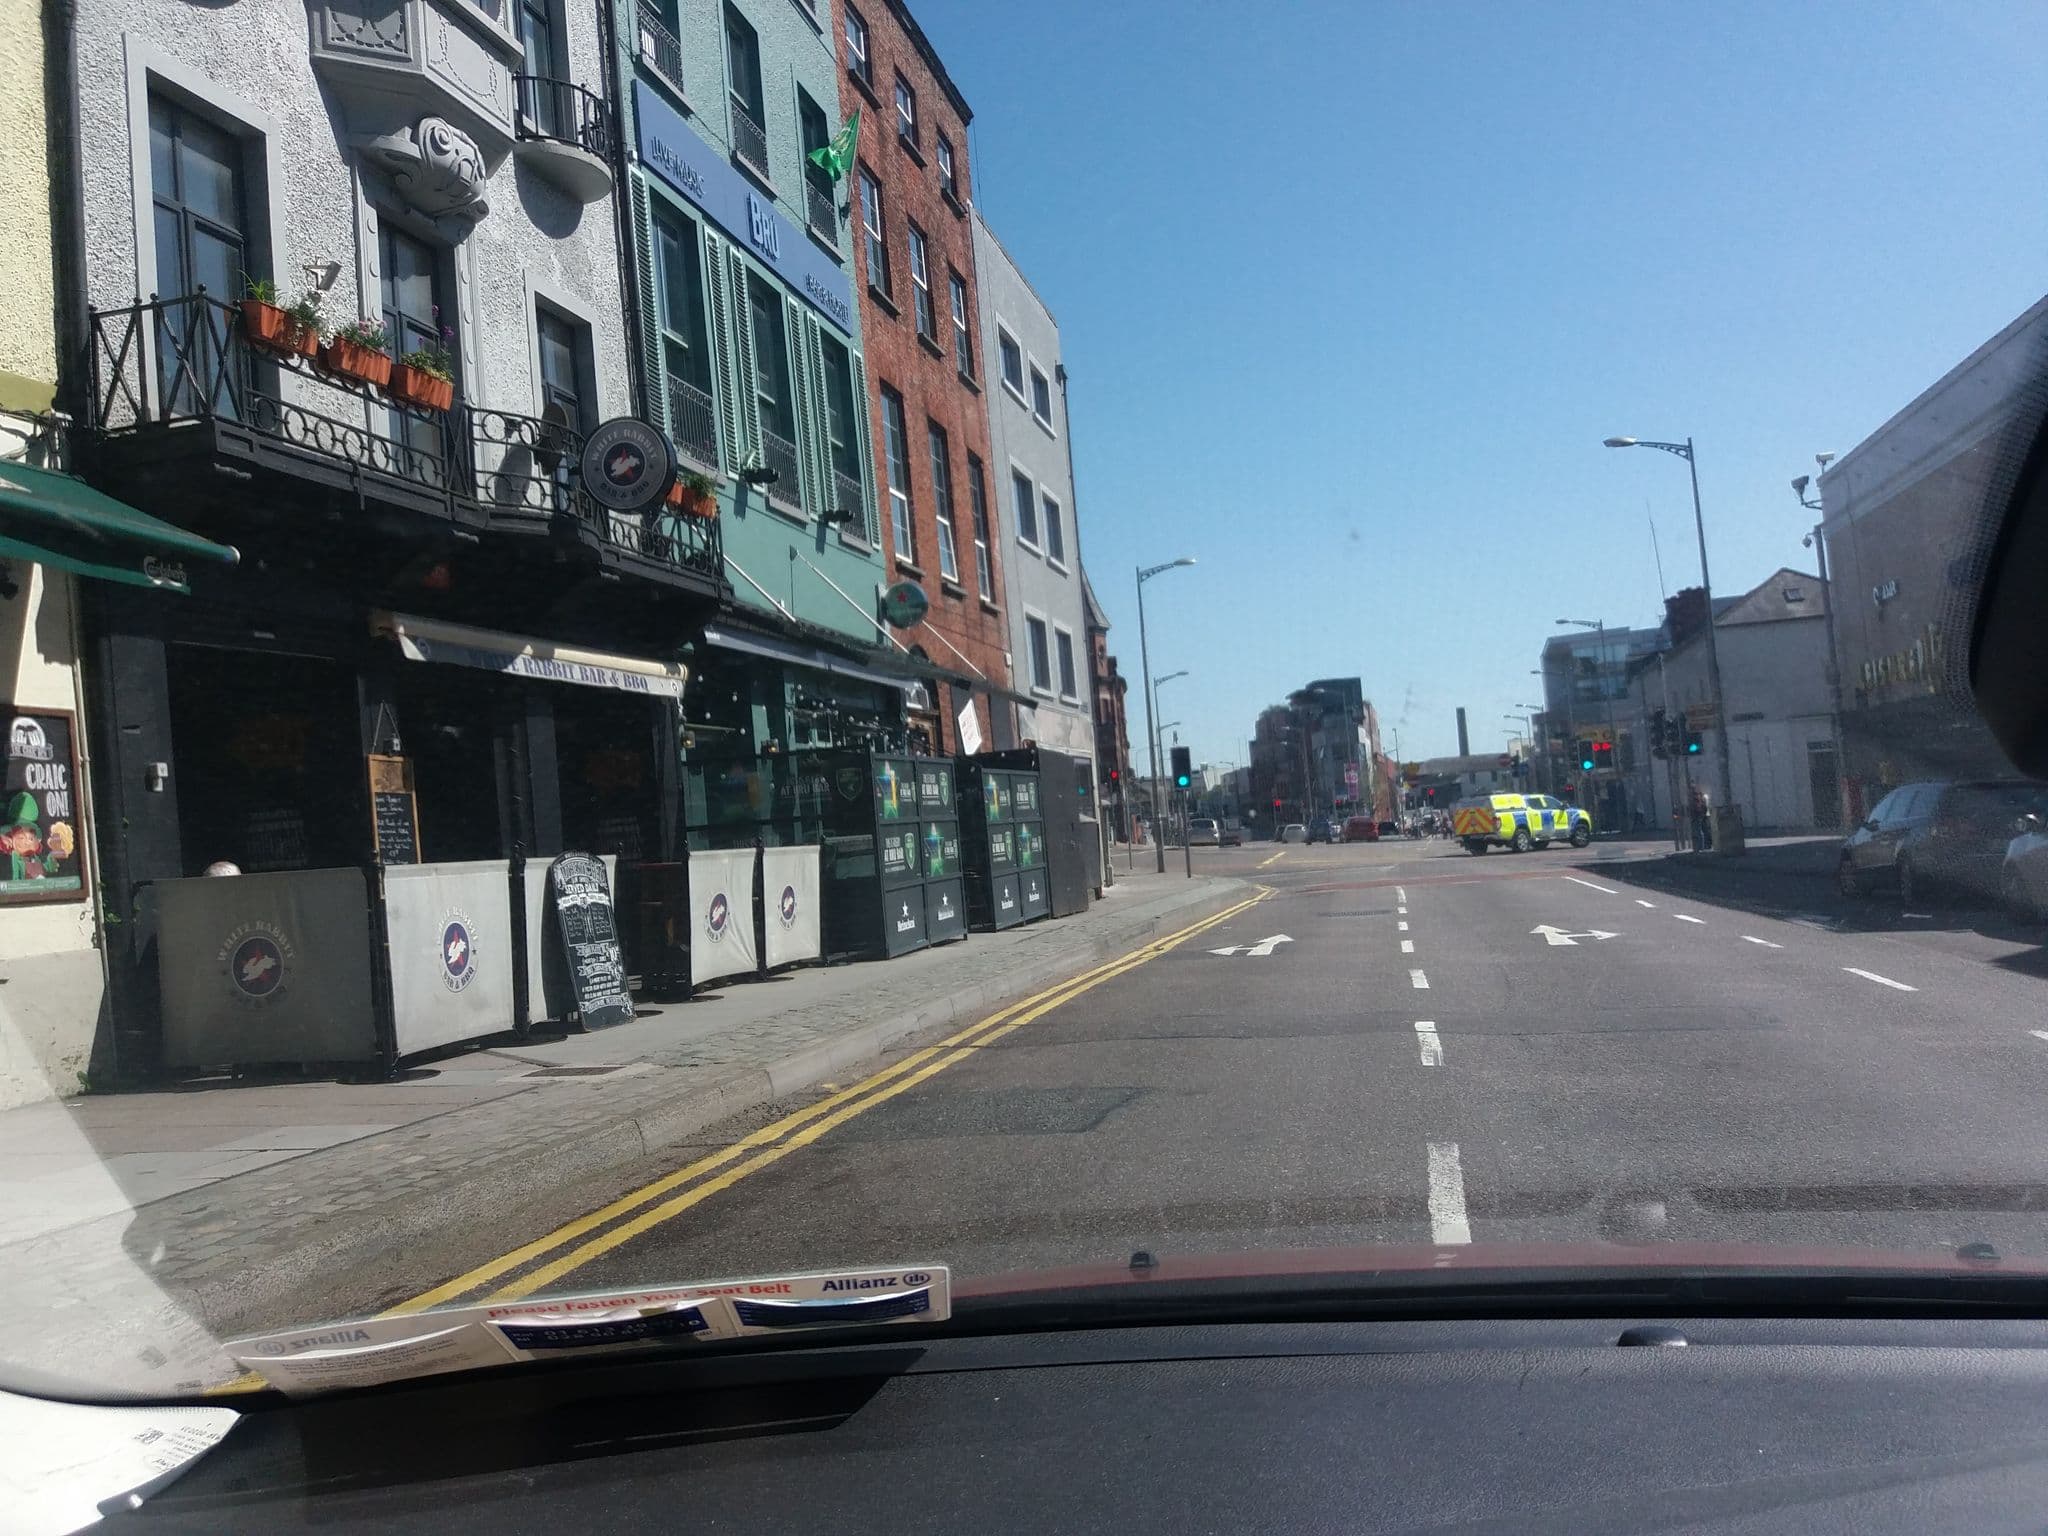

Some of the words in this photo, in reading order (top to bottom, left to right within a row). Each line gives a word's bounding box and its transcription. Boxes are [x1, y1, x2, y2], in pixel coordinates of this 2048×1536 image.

[623, 429, 657, 458] RABBIT
[521, 656, 576, 680] RABBIT
[580, 665, 606, 685] BAR
[608, 671, 620, 686] &
[622, 673, 650, 690] BBQ
[25, 763, 68, 791] CRAIC
[46, 790, 70, 818] ON!
[821, 1276, 897, 1292] Allianz
[488, 1303, 560, 1318] Please
[565, 1295, 636, 1312] Fasten
[641, 1289, 690, 1304] Your
[697, 1285, 744, 1297] Seat
[750, 1282, 792, 1294] Belt
